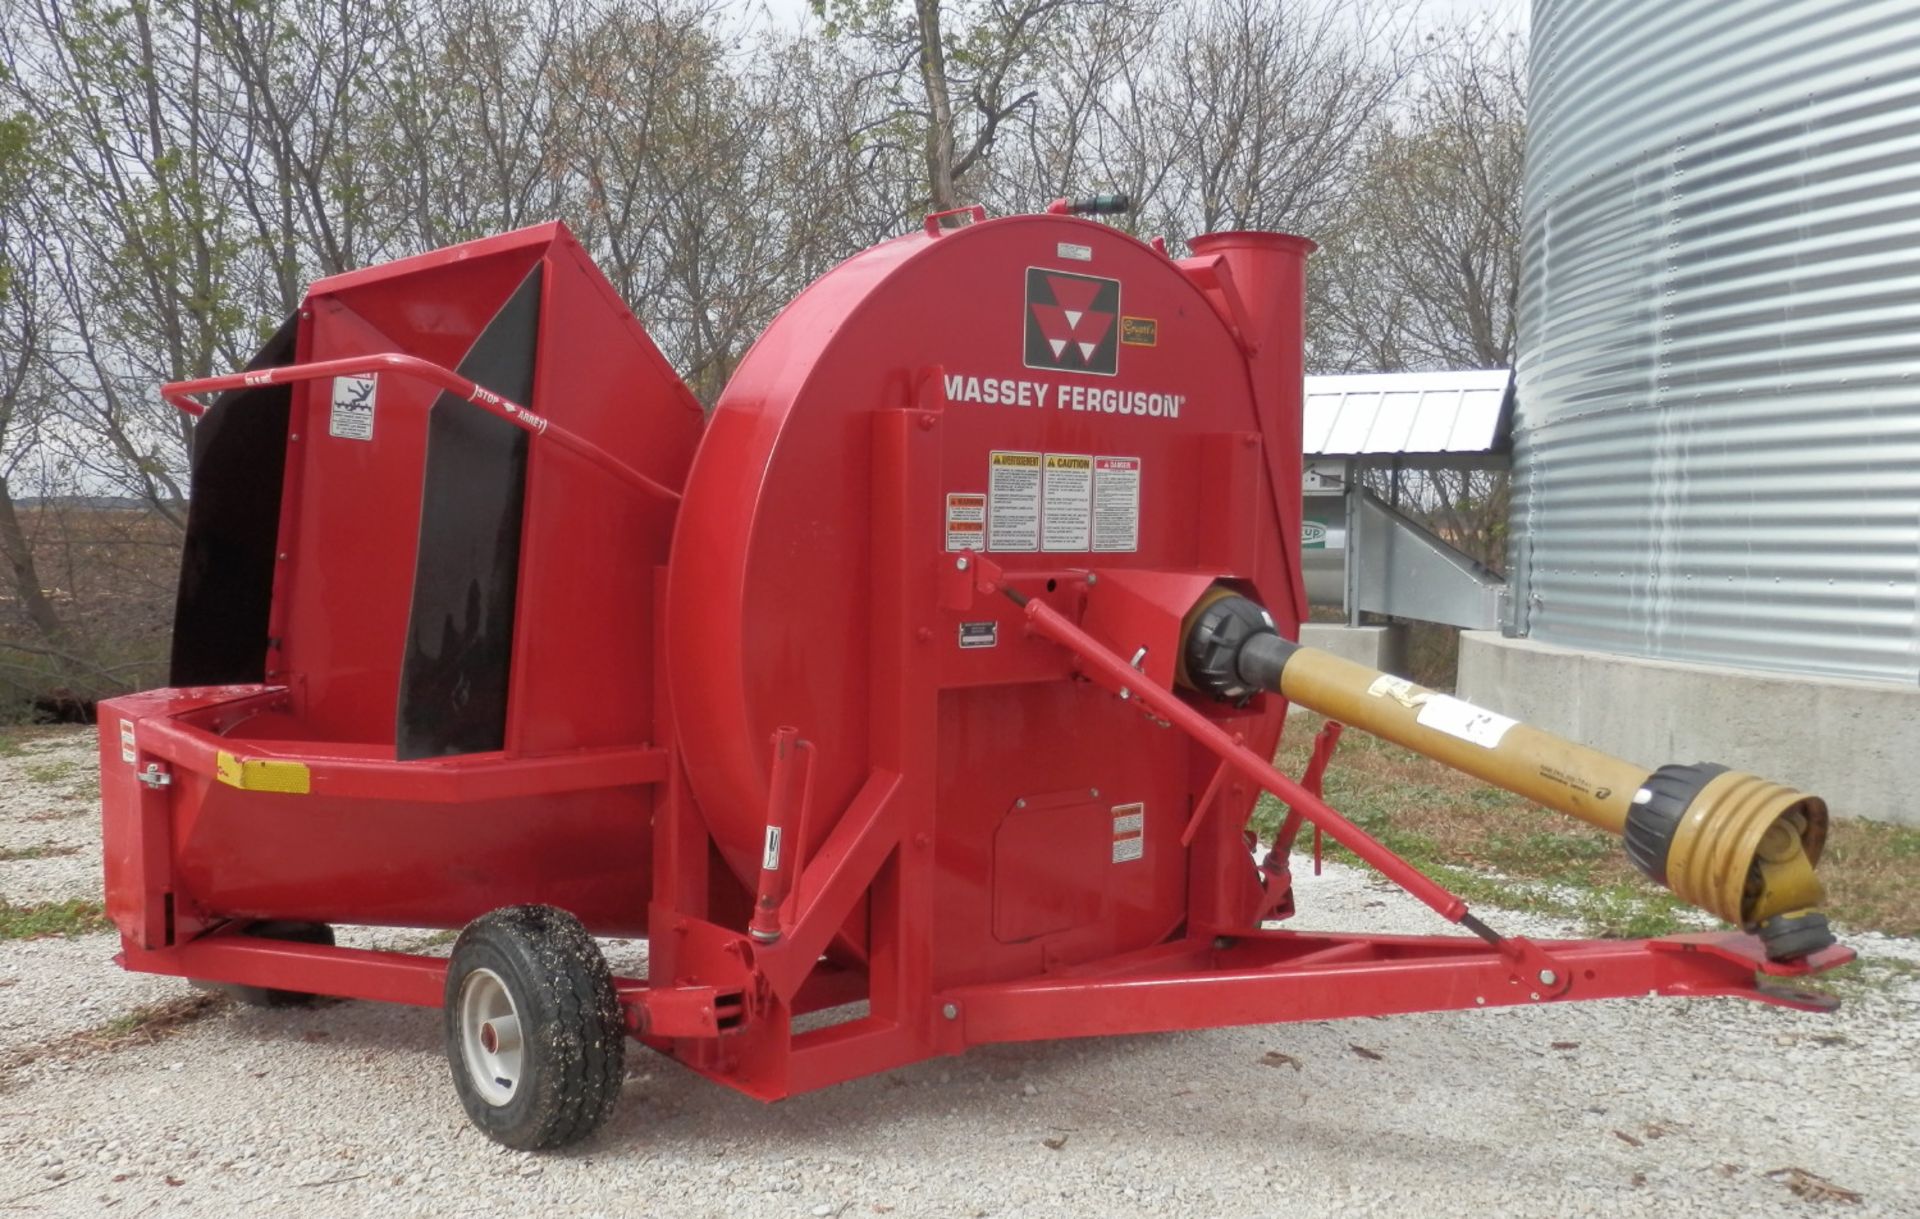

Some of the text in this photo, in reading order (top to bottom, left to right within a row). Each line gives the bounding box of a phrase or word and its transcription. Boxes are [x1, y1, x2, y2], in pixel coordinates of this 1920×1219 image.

[477, 388, 500, 405] STOP
[944, 374, 1048, 407] MASSEY
[1057, 458, 1090, 469] CAUTION
